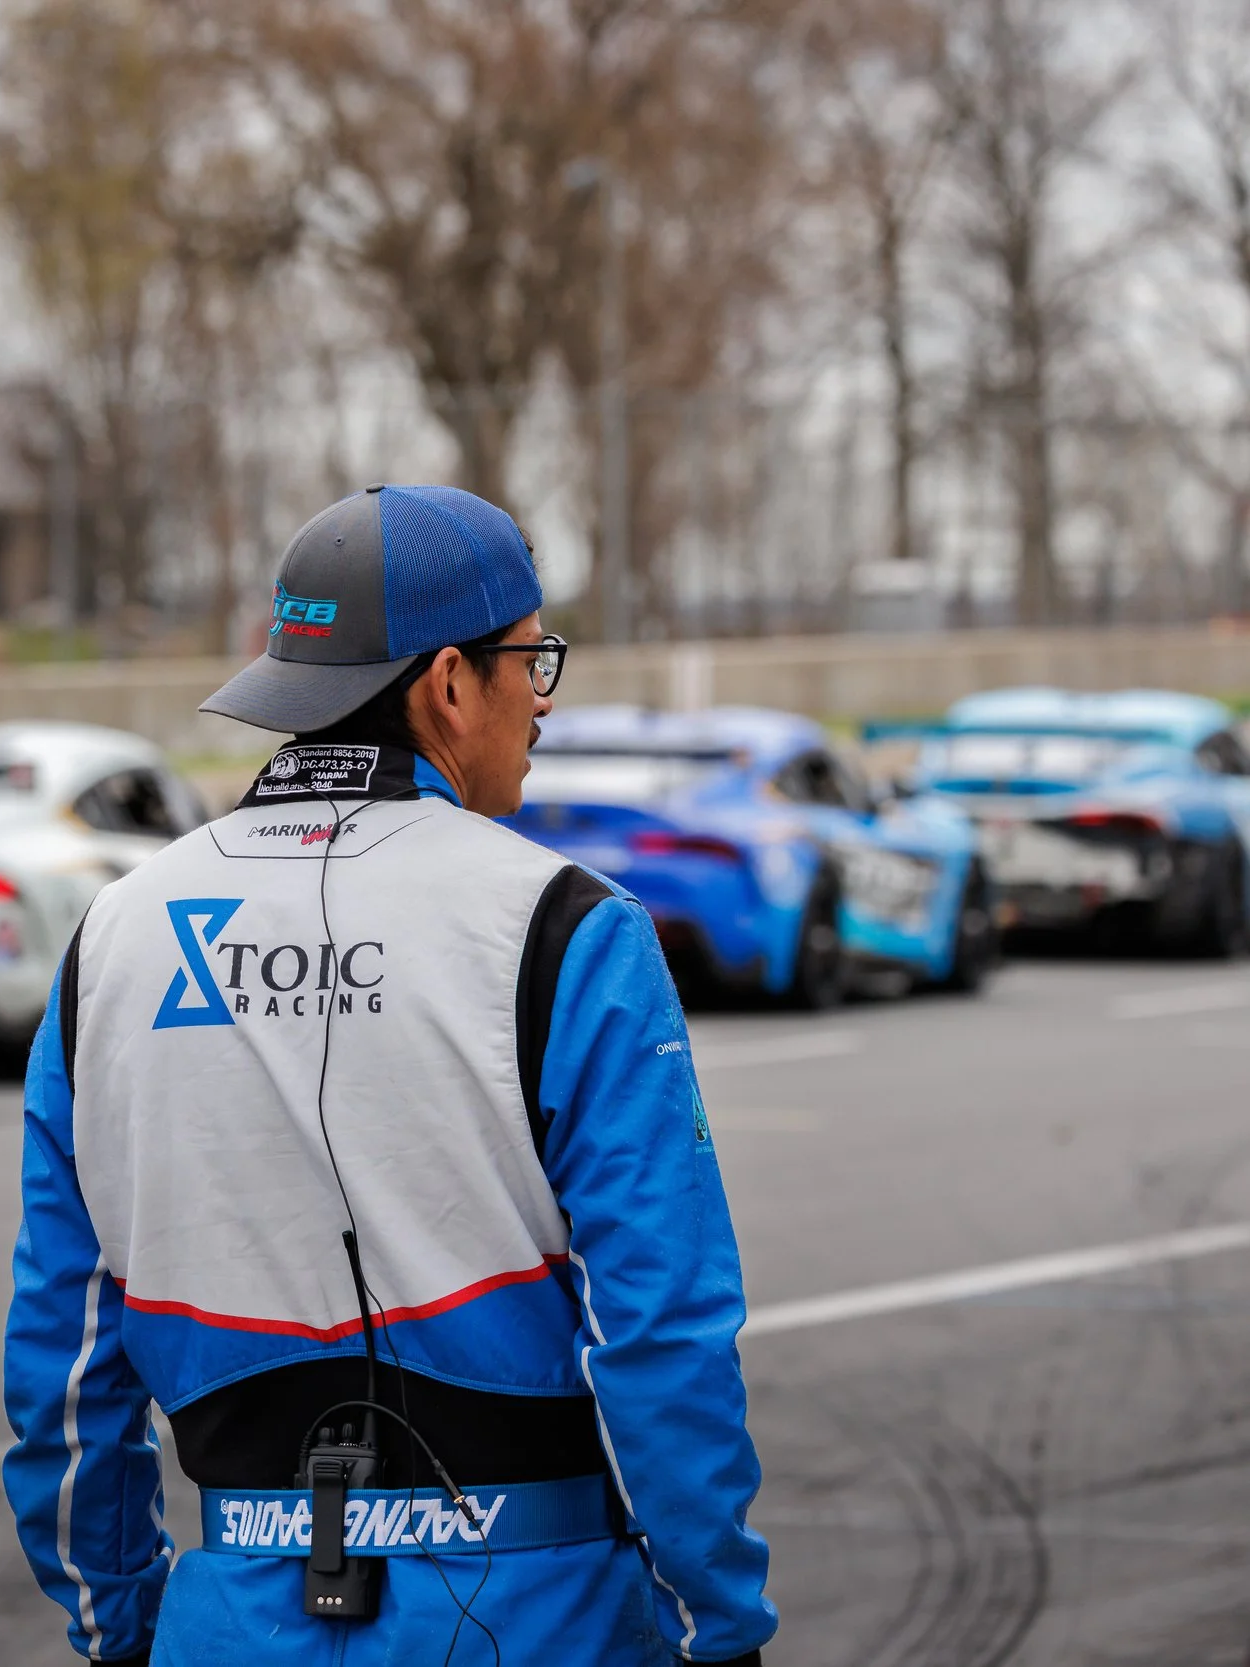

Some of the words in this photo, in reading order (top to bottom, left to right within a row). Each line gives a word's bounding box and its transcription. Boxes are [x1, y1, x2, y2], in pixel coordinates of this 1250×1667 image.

[282, 623, 333, 638] RACING
[297, 749, 332, 758] Standard
[332, 749, 375, 760] 8856-2018
[310, 771, 349, 780] MARINA
[260, 783, 273, 793] Not
[273, 782, 290, 792] valid
[310, 780, 333, 790] 2040
[247, 823, 324, 838] MARINA
[234, 992, 383, 1017] RACING
[342, 1495, 507, 1547] RACING
